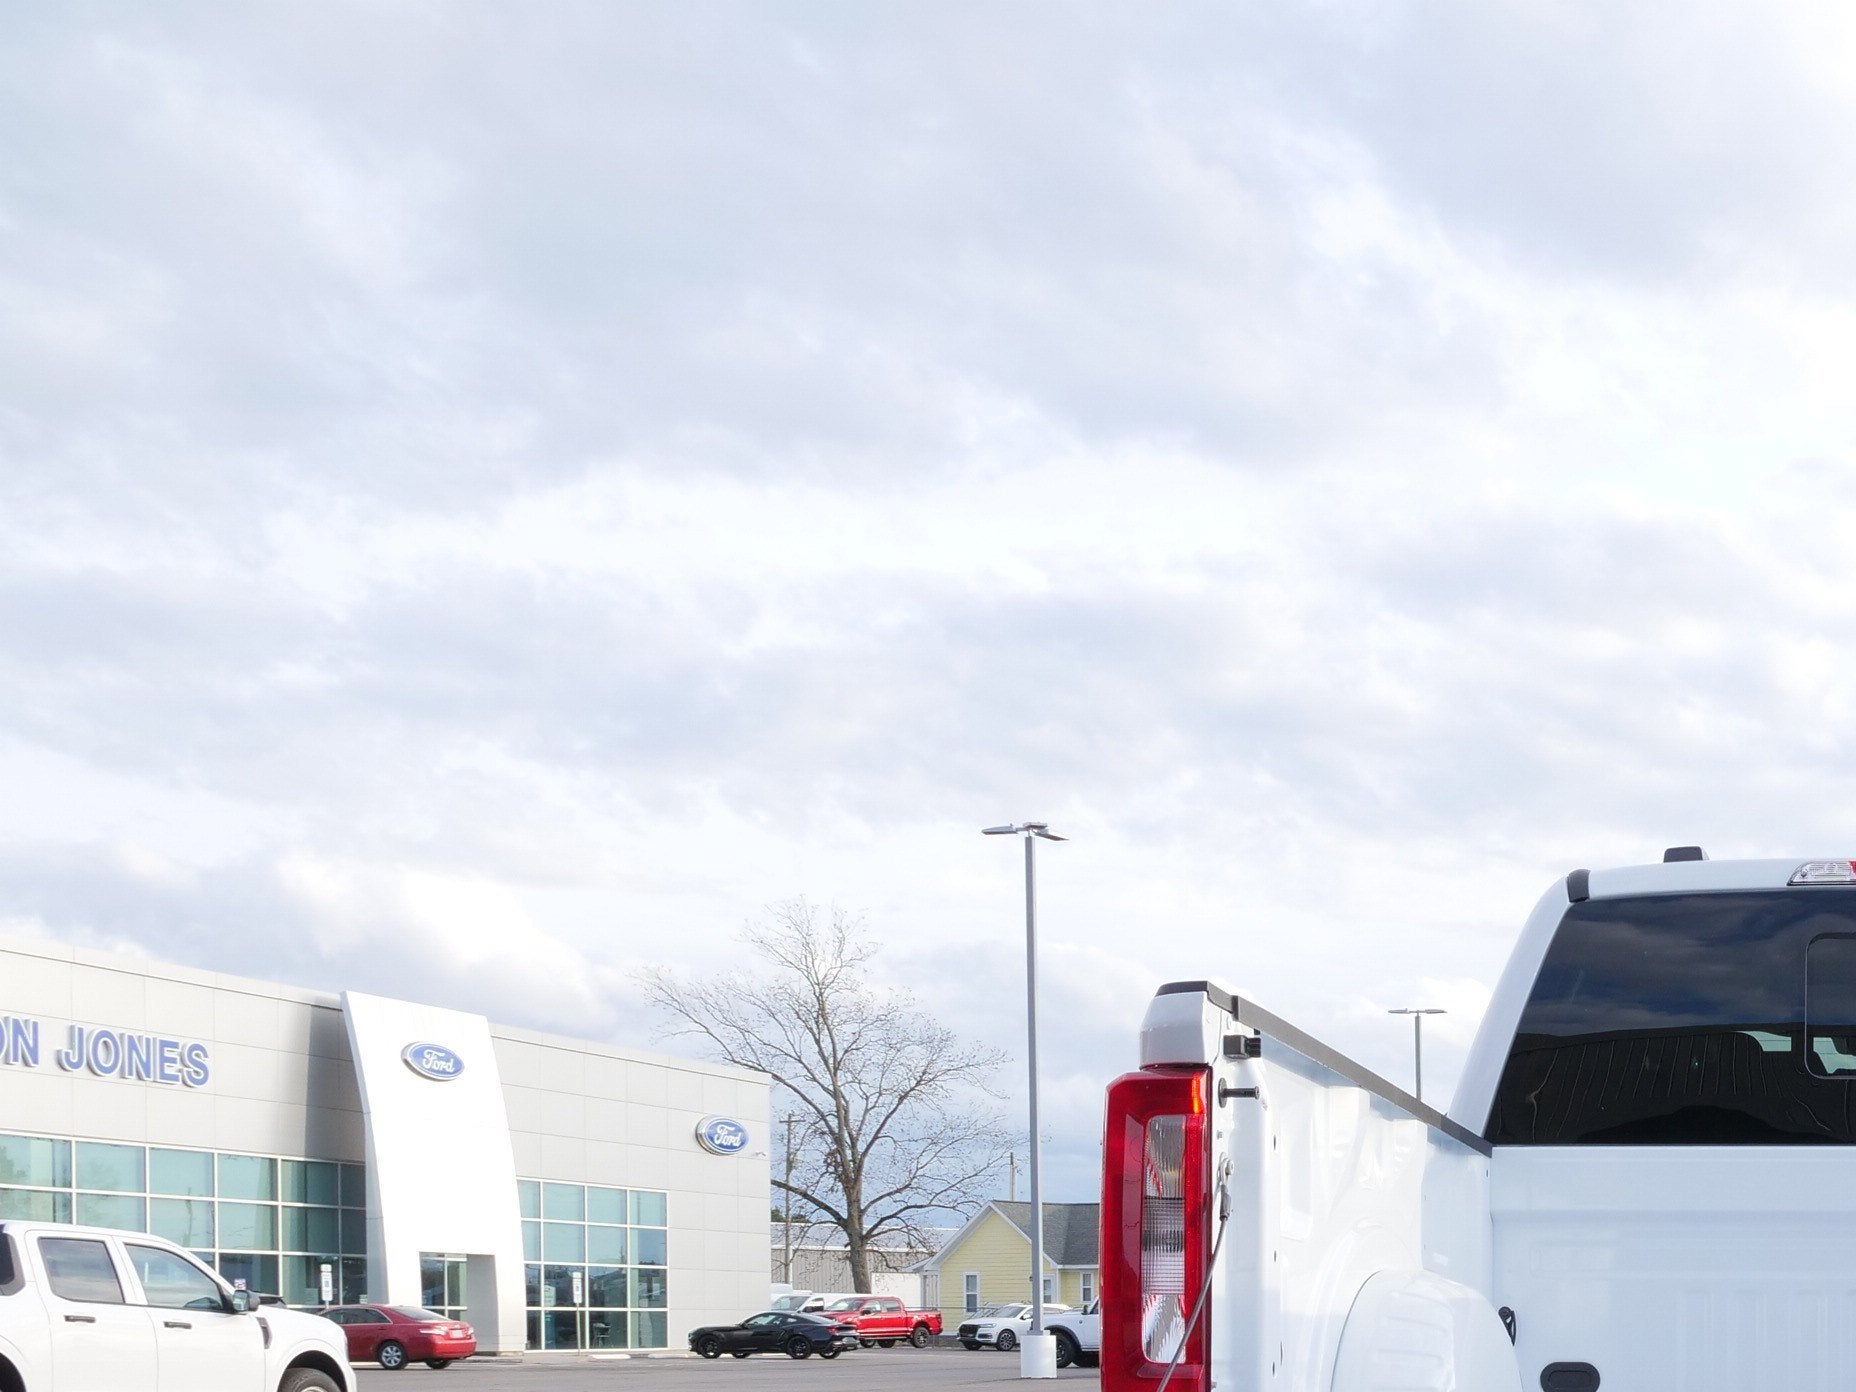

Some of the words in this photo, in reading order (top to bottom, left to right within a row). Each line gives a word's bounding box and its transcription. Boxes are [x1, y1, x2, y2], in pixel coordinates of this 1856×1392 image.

[0, 1017, 39, 1066] N
[59, 1025, 210, 1088] JONES
[422, 1049, 455, 1073] Ford
[713, 1124, 742, 1147] Ford
